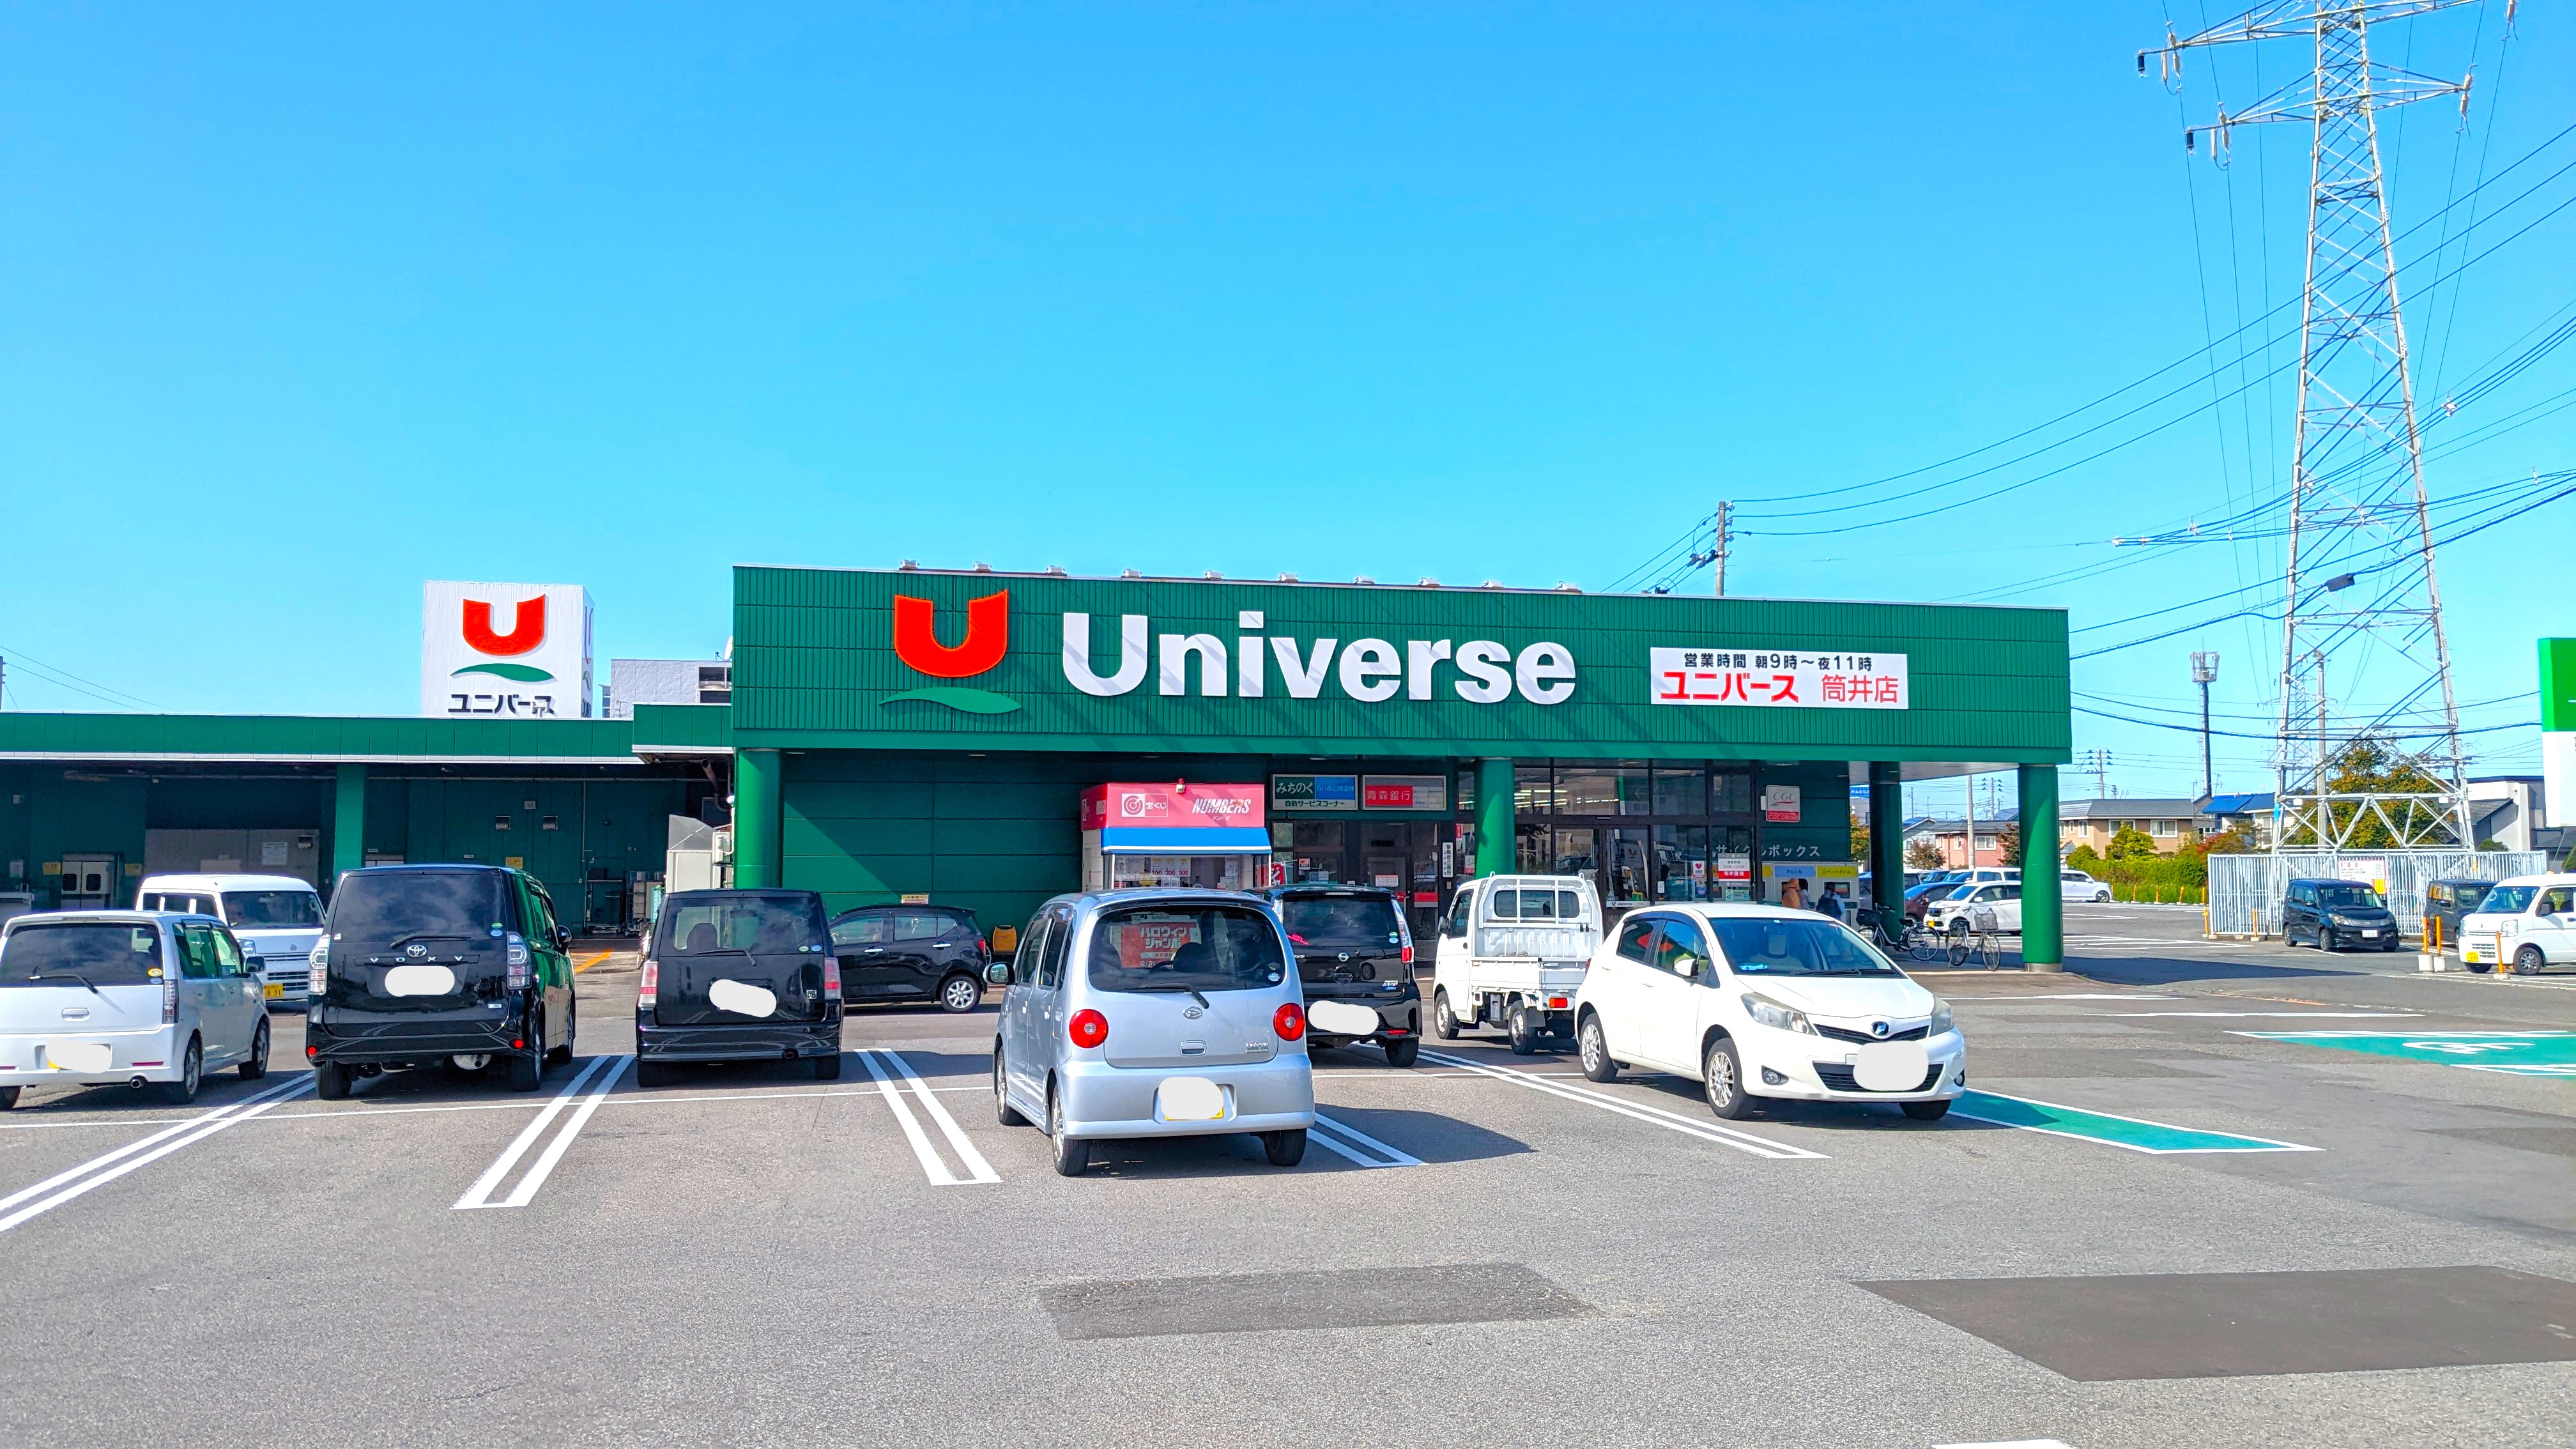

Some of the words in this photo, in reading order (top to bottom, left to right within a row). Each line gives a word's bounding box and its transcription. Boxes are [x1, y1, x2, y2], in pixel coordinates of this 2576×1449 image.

[1062, 611, 1575, 705] Universe
[1684, 652, 1747, 669] 営業時間
[1660, 671, 1799, 703] ユニバース
[1821, 674, 1899, 703] 筒井店
[448, 694, 555, 715] ユニバース
[1276, 782, 1313, 794] みちのく
[1367, 790, 1411, 801] 青森銀行
[1773, 792, 1793, 801] CGC
[1192, 798, 1252, 814] NUMBERS
[1140, 926, 1189, 938] ハロウィン
[1146, 937, 1181, 949] ジャンボ
